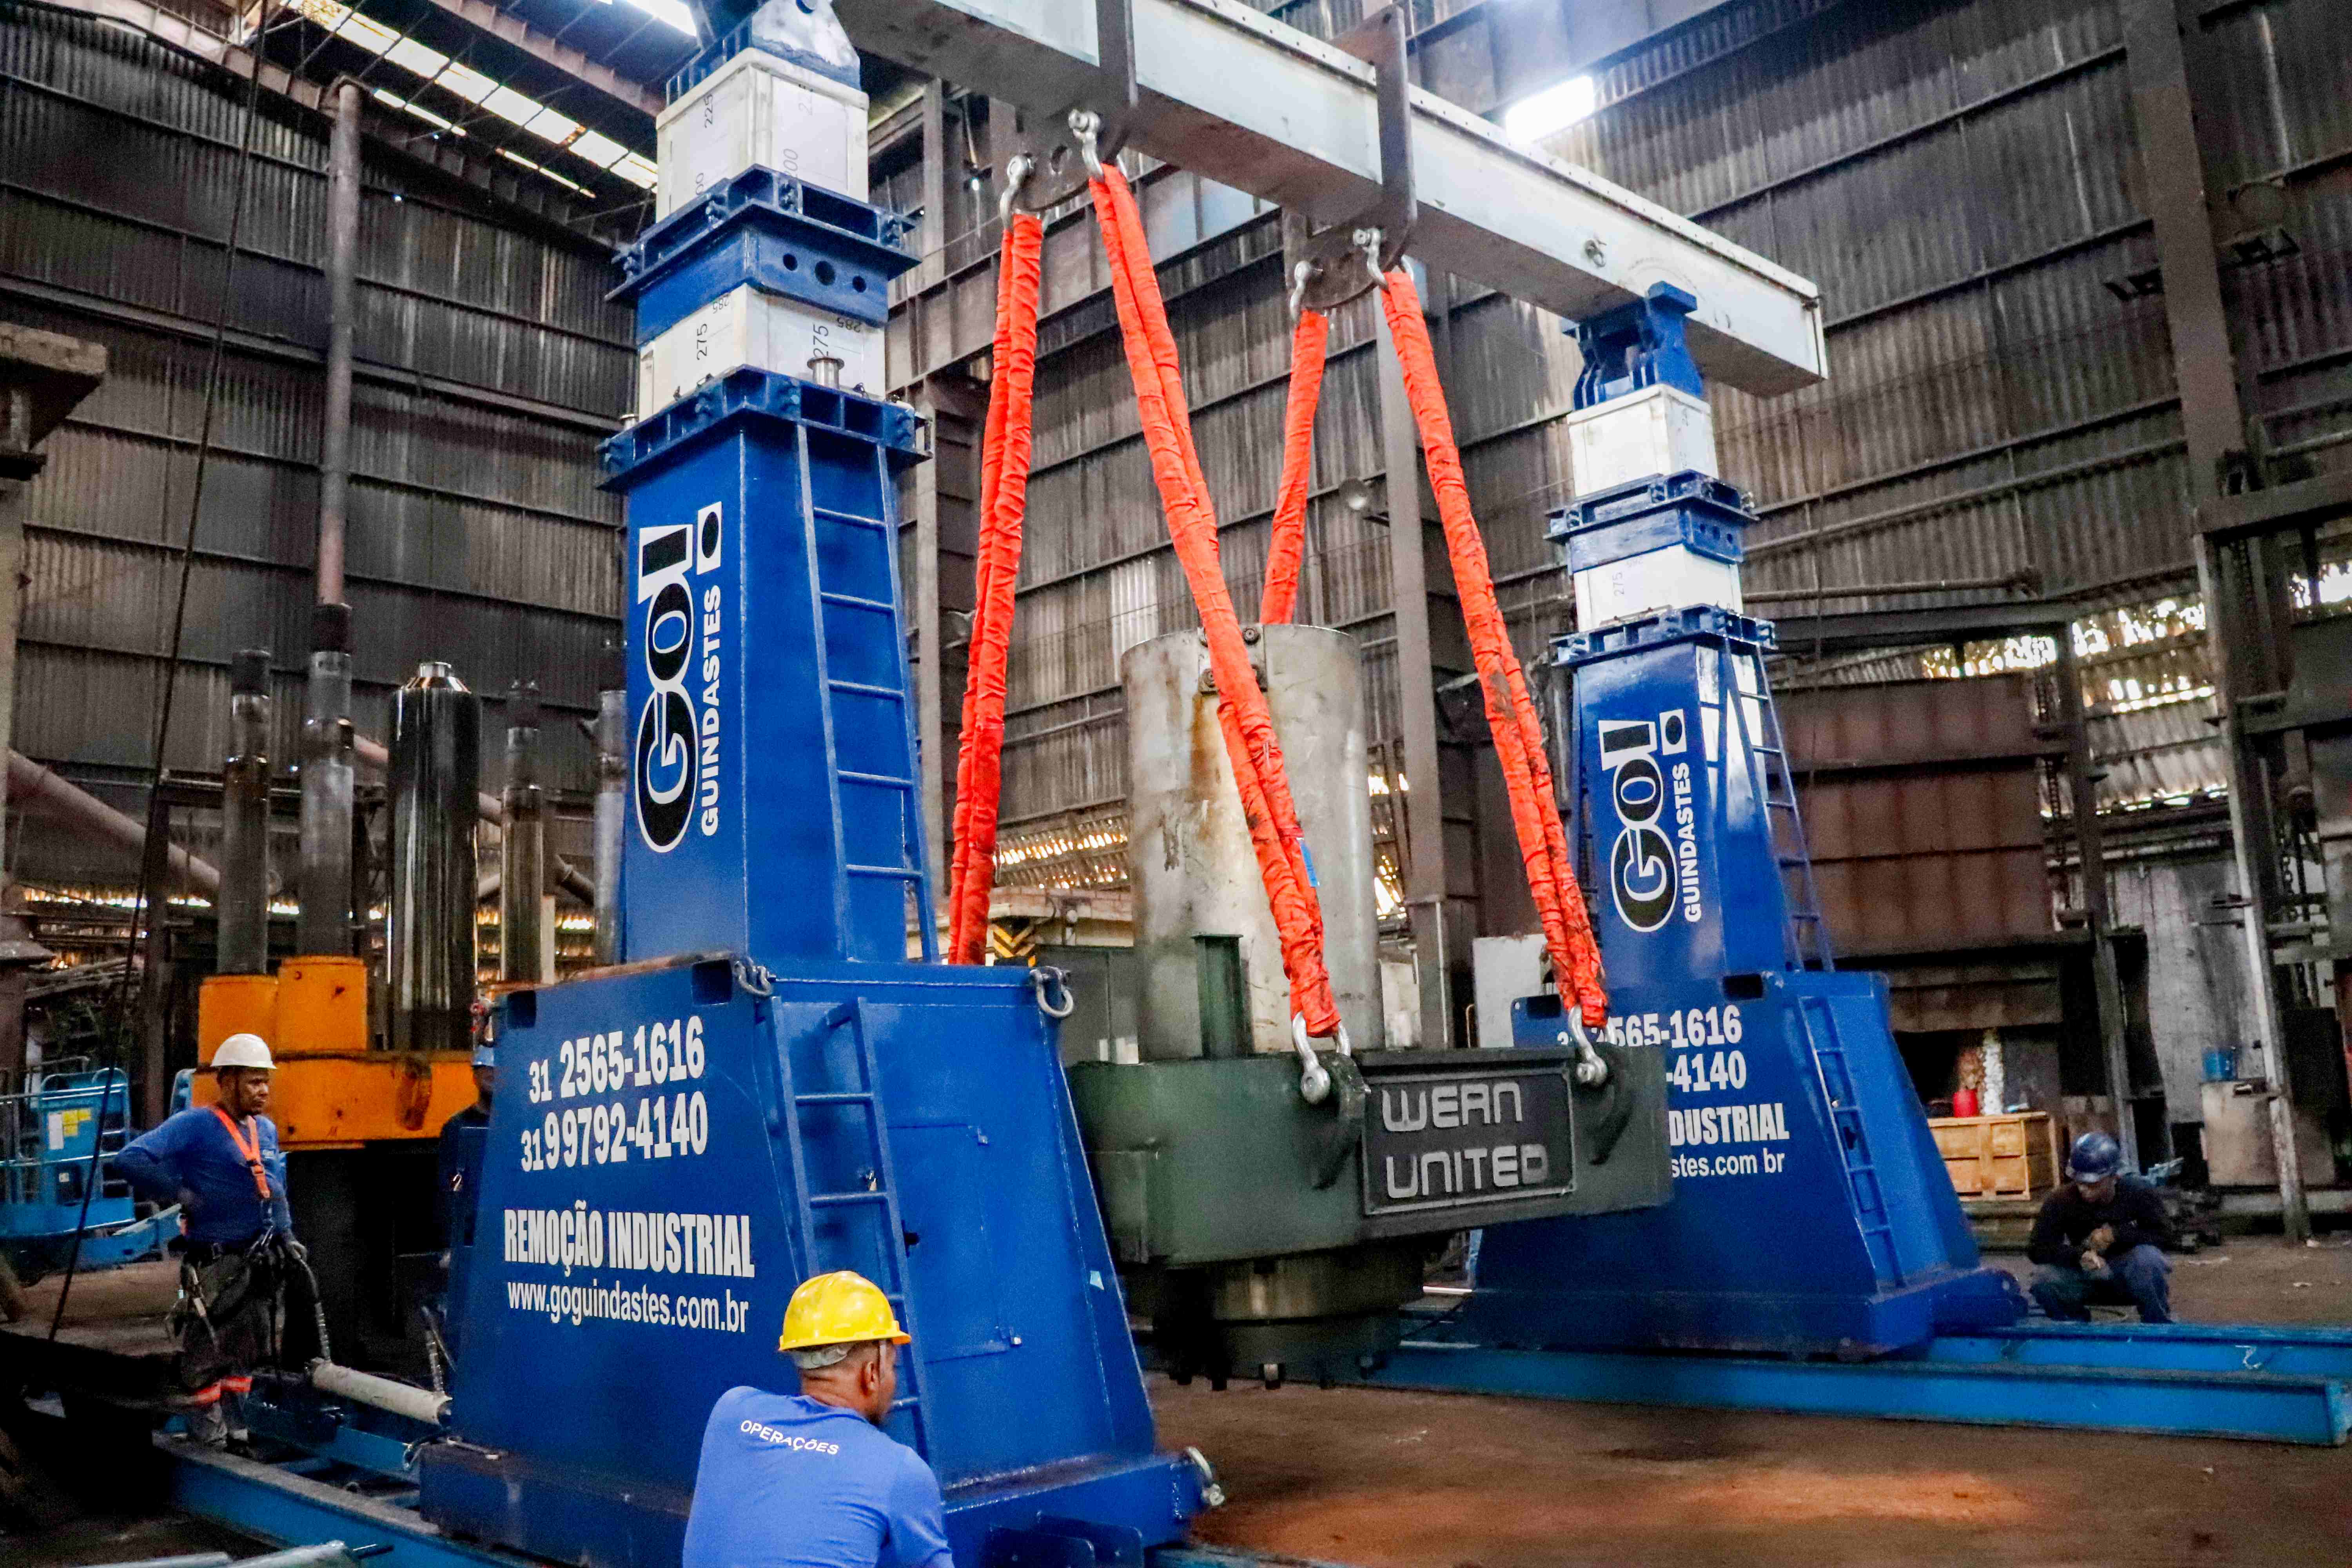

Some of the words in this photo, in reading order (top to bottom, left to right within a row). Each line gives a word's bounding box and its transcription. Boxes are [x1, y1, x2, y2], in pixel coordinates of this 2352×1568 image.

[704, 94, 713, 128] 225
[697, 323, 708, 361] 275
[813, 323, 829, 358] 275
[701, 585, 721, 837] GUINDASTES
[1672, 762, 1702, 922] GUINDASTES
[1591, 1005, 1742, 1047] 565-1616
[529, 1059, 552, 1103] 31
[560, 1015, 706, 1098] 2565-1616
[1386, 1143, 1548, 1198] UNITED
[504, 1200, 604, 1278] REMOÇÃO
[608, 1211, 755, 1278] INDUSTRIAL
[507, 1279, 749, 1333] www.goguindastes.com.br
[740, 1420, 839, 1455] OPERAÇÕES
